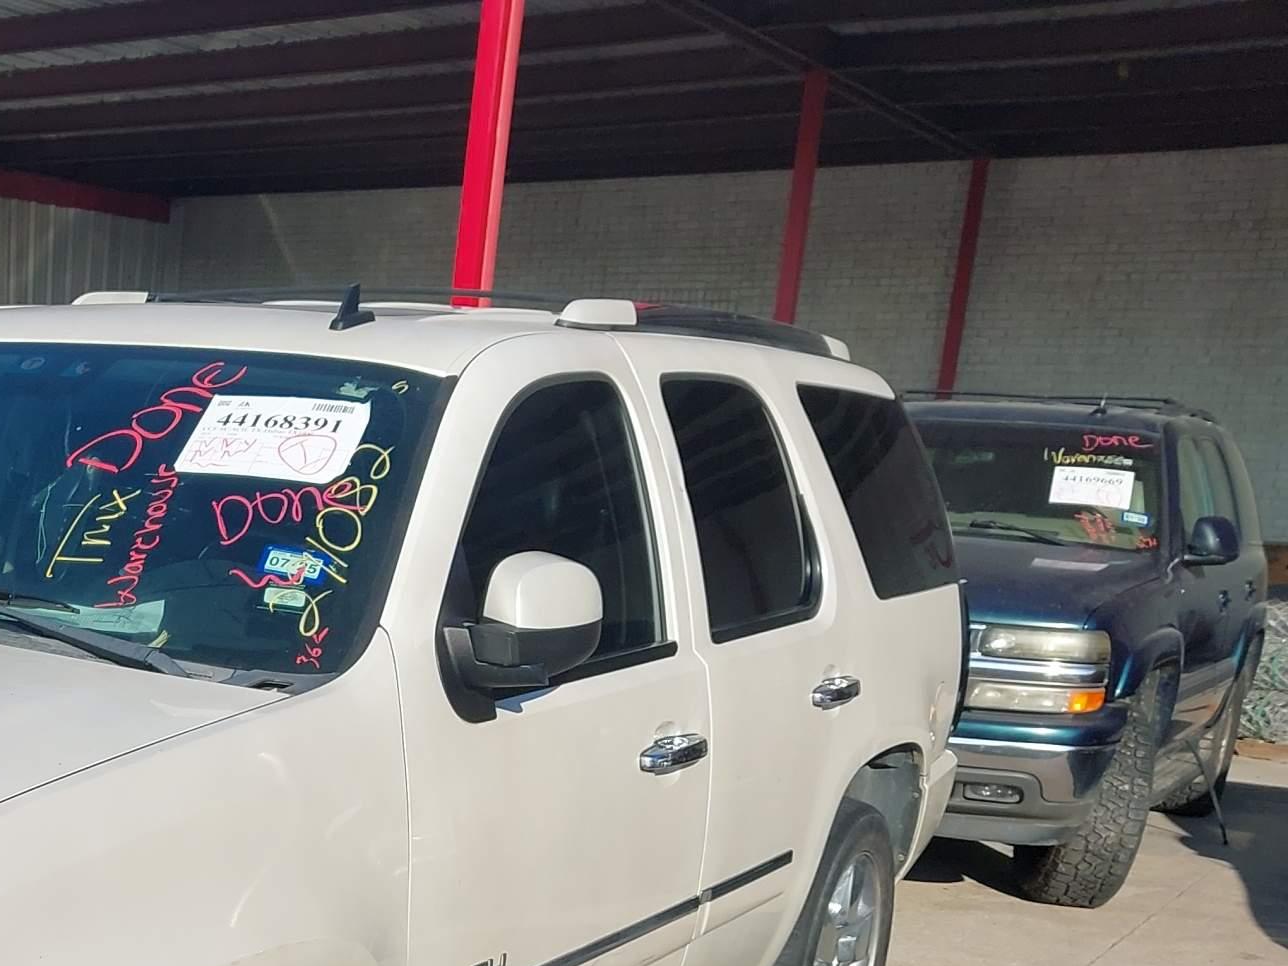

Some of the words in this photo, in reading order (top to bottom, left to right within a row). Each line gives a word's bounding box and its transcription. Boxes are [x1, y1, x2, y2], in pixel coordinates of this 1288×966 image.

[66, 361, 248, 474] Done
[216, 412, 343, 434] 44168391
[1081, 434, 1155, 452] Done
[211, 478, 368, 545] Done
